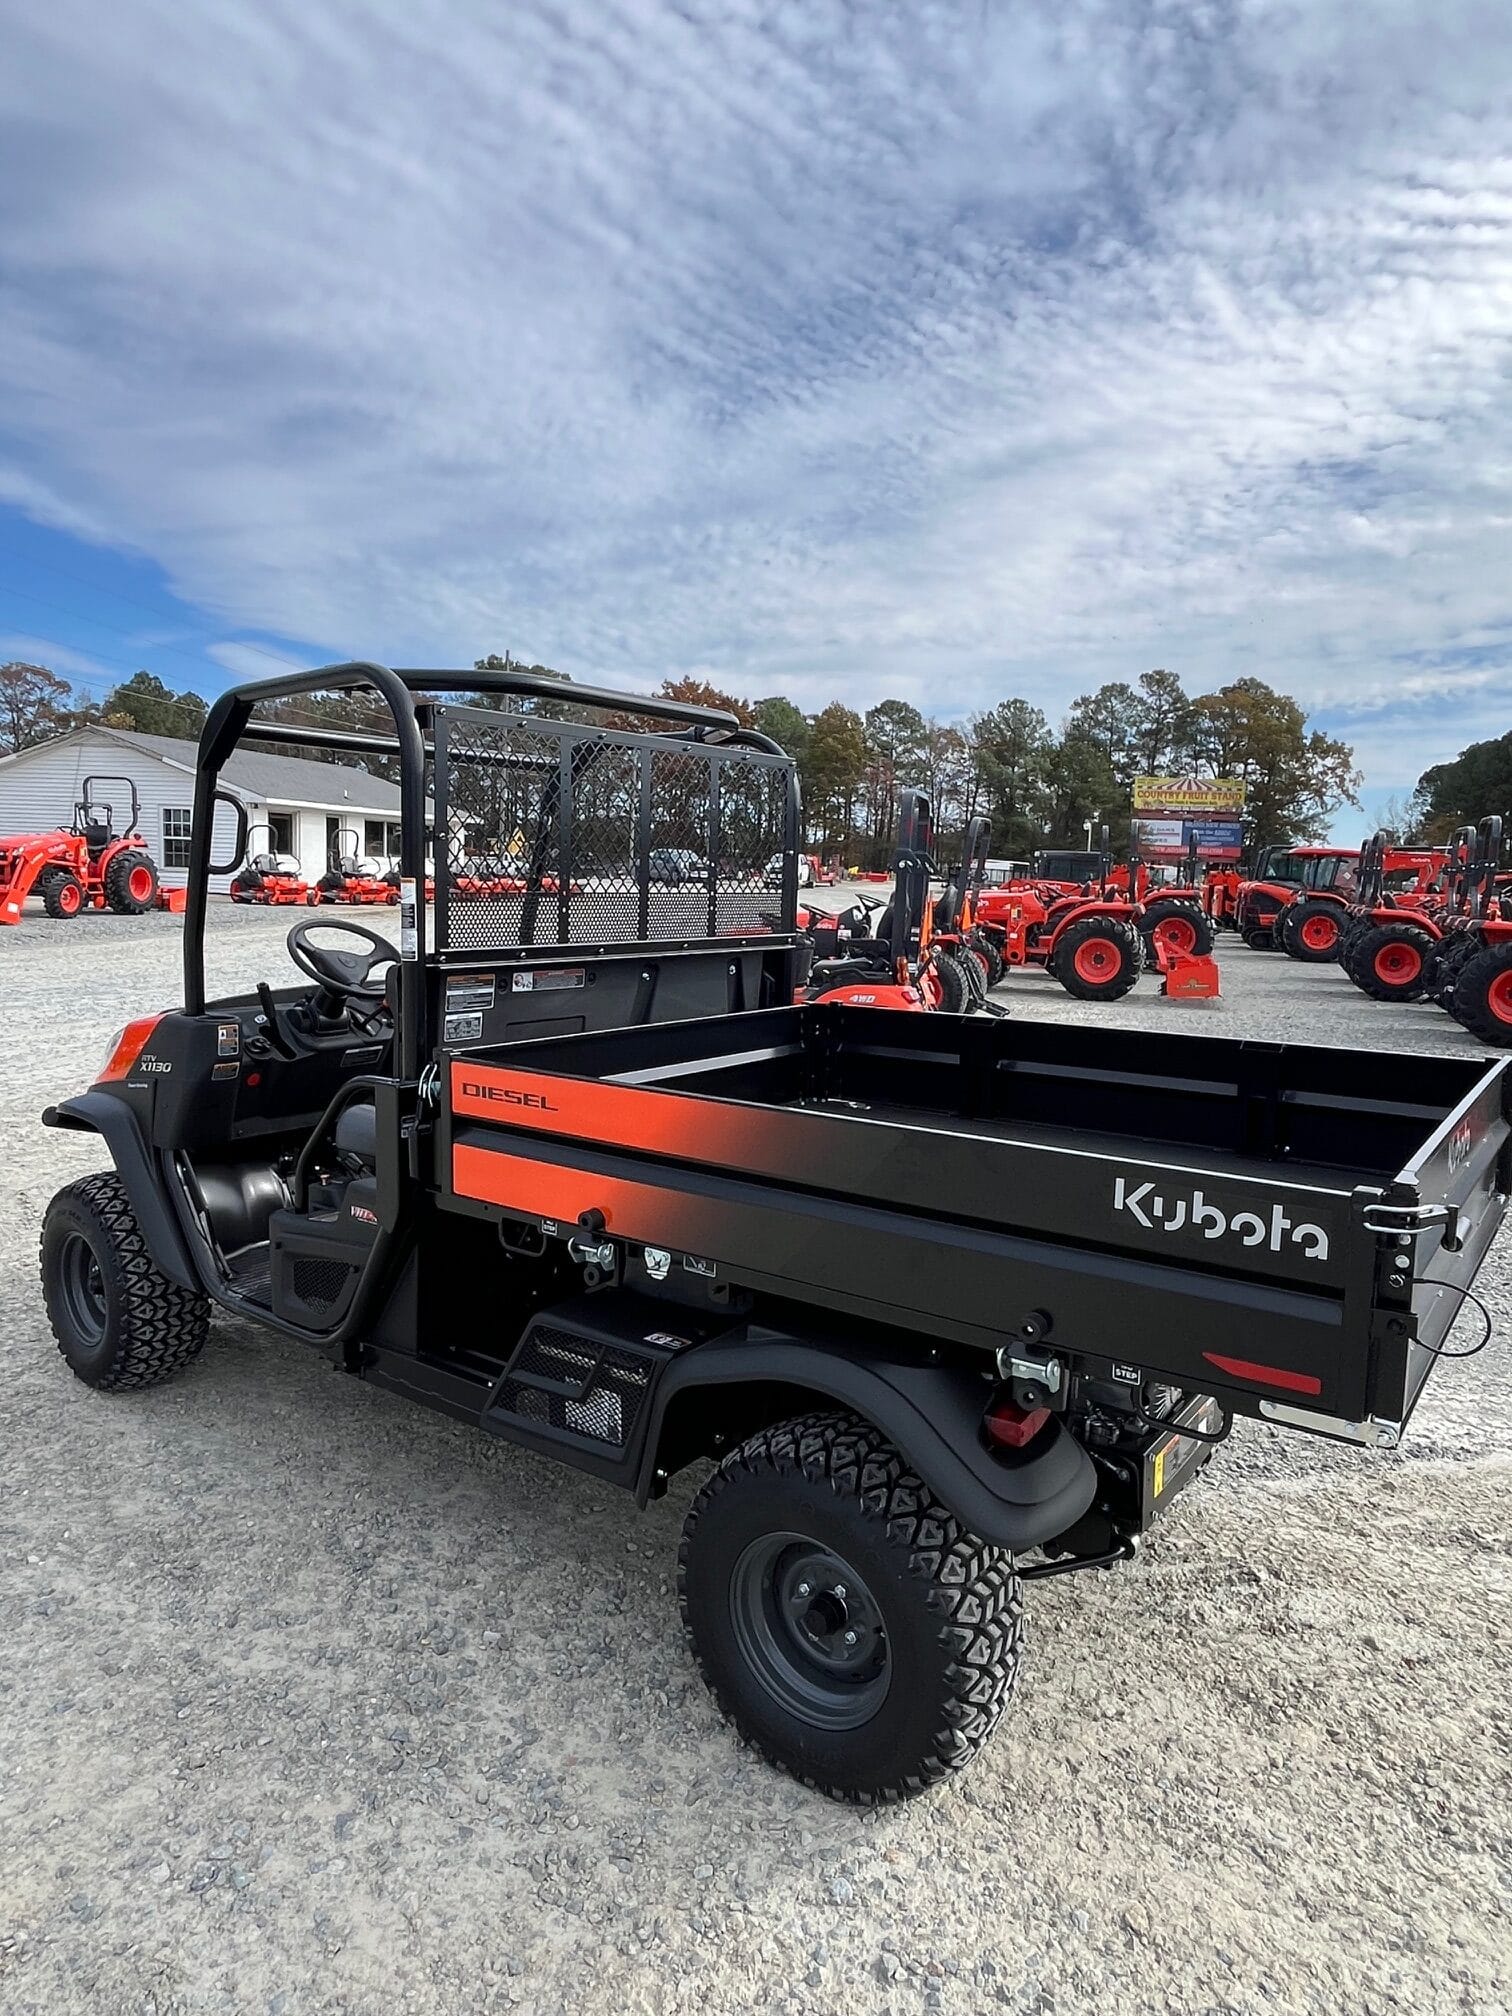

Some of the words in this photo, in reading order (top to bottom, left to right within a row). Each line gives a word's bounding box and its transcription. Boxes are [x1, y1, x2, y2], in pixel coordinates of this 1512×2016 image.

[1137, 790, 1180, 799] COUNTRY
[1182, 790, 1209, 800] FRUIT
[1211, 791, 1242, 800] STAND
[849, 994, 876, 1004] 4WD
[141, 1054, 157, 1062] RTV
[140, 1062, 172, 1073] X1130
[462, 1082, 559, 1112] DIESEL
[1114, 1177, 1329, 1261] Kubota
[1115, 1368, 1138, 1379] STEP
